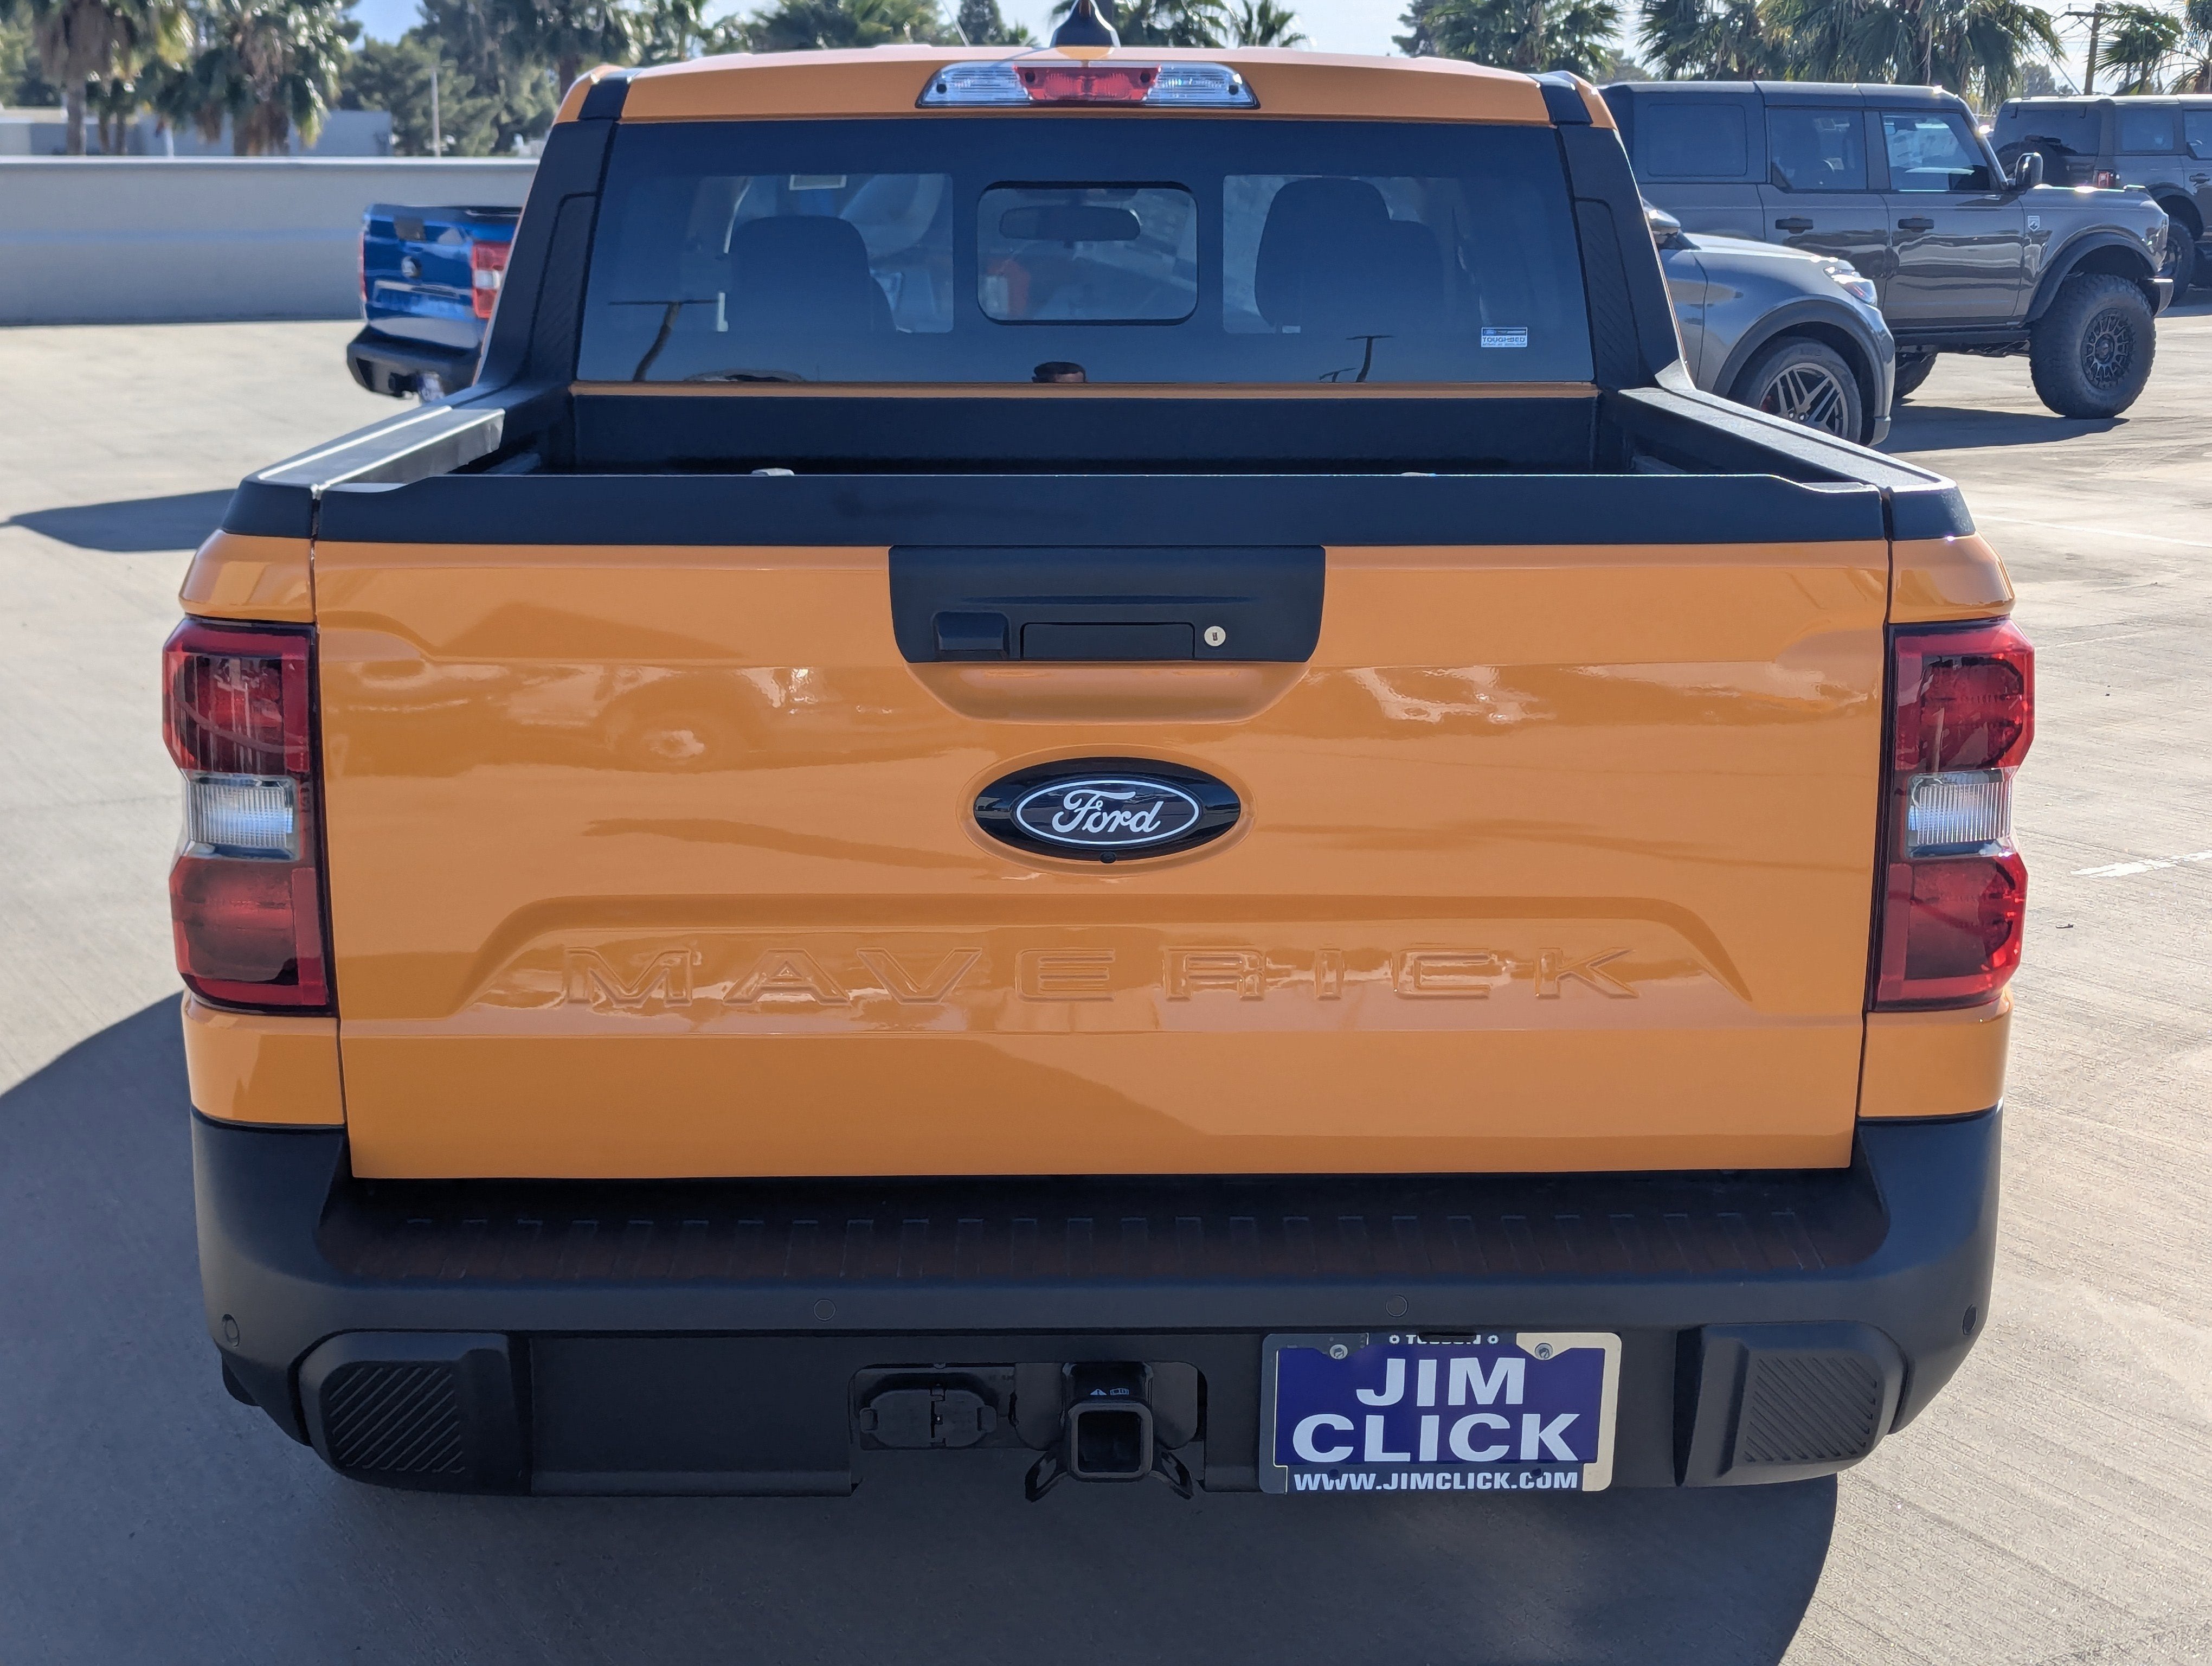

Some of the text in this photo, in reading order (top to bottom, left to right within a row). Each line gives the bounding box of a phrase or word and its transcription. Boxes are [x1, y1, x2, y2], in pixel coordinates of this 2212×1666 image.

[1052, 789, 1164, 833] Ford
[563, 945, 1639, 1007] MAVERICK
[1356, 1357, 1526, 1406] JIM
[1293, 1413, 1580, 1462] CLICK
[1294, 1471, 1578, 1491] WWW.JIMCLICK.COM
